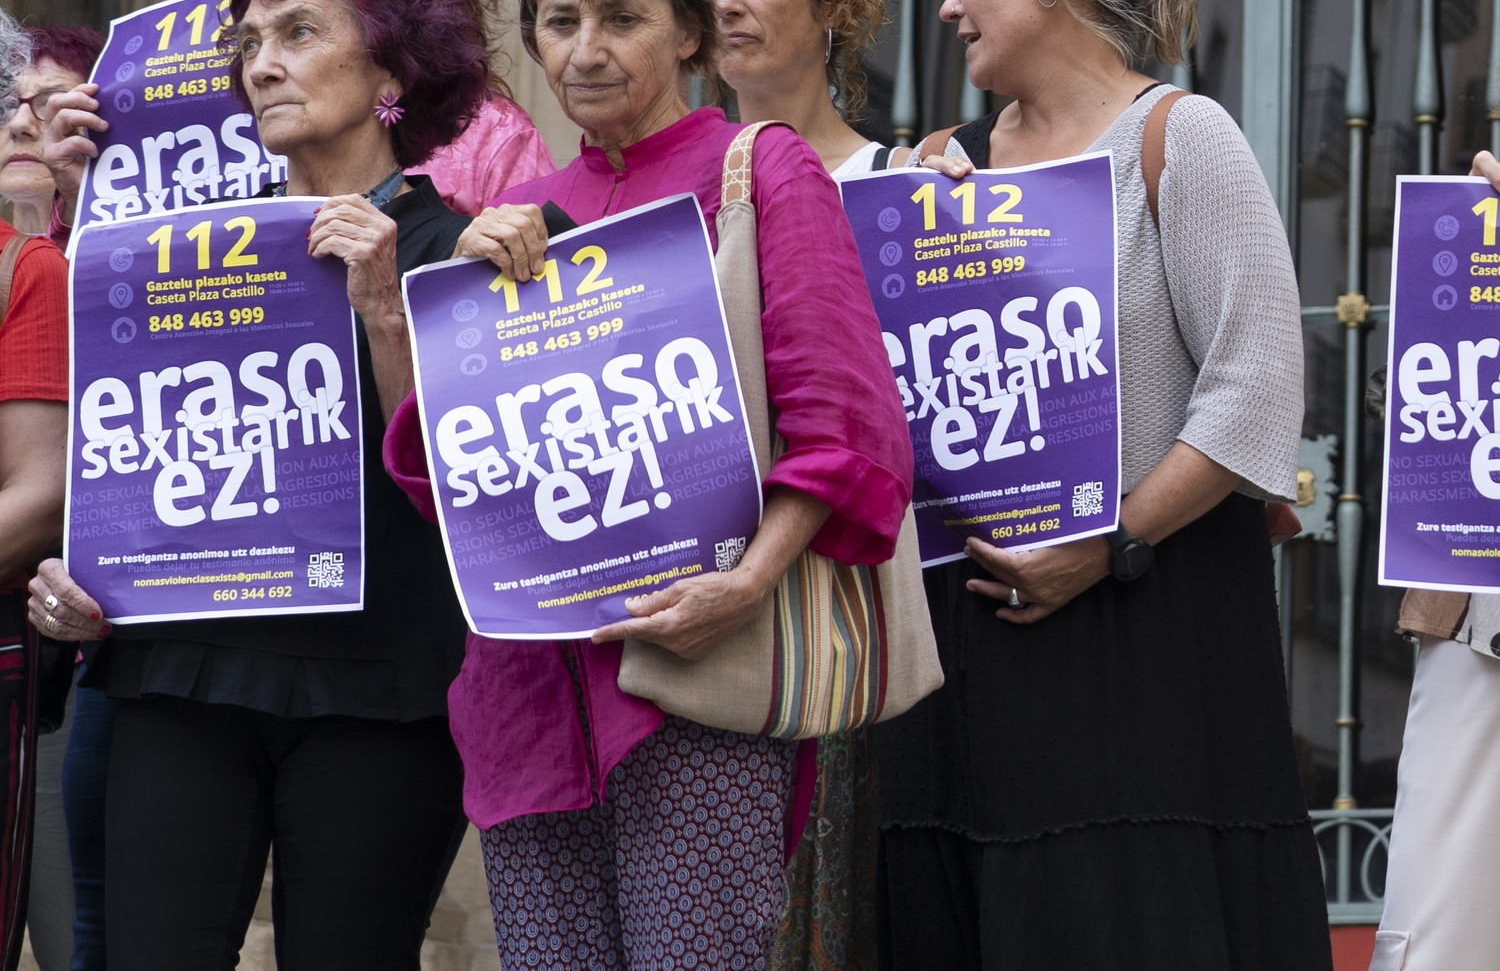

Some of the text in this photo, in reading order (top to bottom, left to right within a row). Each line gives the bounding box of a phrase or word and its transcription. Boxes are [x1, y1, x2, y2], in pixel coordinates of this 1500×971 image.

[144, 66, 177, 77] Caseta
[180, 63, 204, 72] Plaza
[146, 53, 184, 66] Gaztelu
[145, 75, 230, 101] 848 463 99
[910, 182, 1023, 230] 112
[145, 216, 258, 273] 112
[914, 227, 1051, 248] Gaztelu plazako kaseta
[915, 238, 1027, 260] Caseta Plaza Castillo
[146, 271, 287, 291] Gaztelu plazako kaseta
[488, 245, 613, 313] 112
[916, 256, 1025, 286] 848 463 999
[146, 285, 265, 304] Caseta Plaza Castillo
[496, 284, 645, 329] Gaztelu plazako kaseta
[149, 307, 264, 332] 848 463 999
[496, 301, 622, 339] Caseta Plaza Castillo
[500, 317, 623, 361] 848 463 999
[897, 327, 1108, 422] existarik
[80, 343, 343, 447] eraso
[436, 338, 717, 472] eraso
[82, 387, 350, 478] sexistarik
[447, 377, 733, 505] sexistarik
[931, 386, 1045, 470] ez!
[153, 445, 280, 526] ez!
[535, 440, 671, 539] ez!
[959, 489, 1002, 502] anonimoa
[1005, 487, 1019, 495] utz
[1021, 480, 1061, 493] dezakezu
[992, 518, 1060, 540] 660 344 692
[1417, 523, 1439, 531] Zure
[1441, 523, 1494, 534] testigantza
[98, 546, 295, 565] Zure testigantza anonimoa utz dezakezu
[493, 538, 698, 591] Zure testigantza anonimoa utz dezakezu
[134, 571, 294, 587] nomasviolenciasexista@gmail.com
[213, 586, 292, 601] 660 344 692
[537, 563, 702, 609] nomasviolenciasexista@gmail.com
